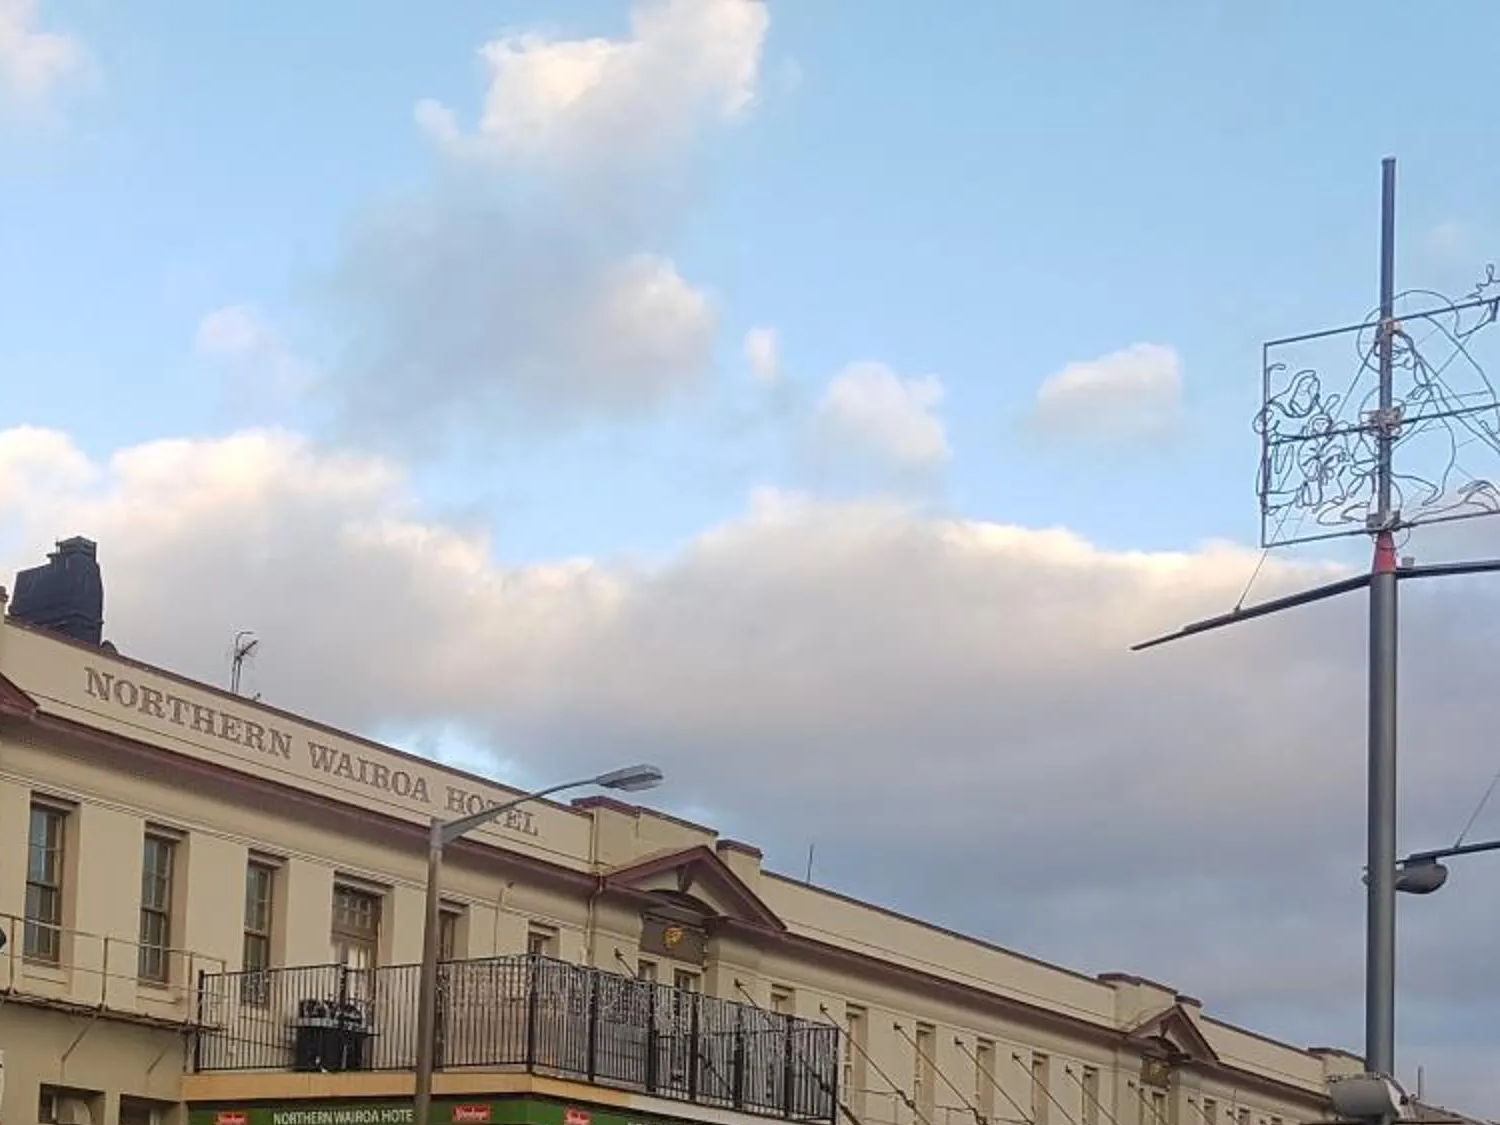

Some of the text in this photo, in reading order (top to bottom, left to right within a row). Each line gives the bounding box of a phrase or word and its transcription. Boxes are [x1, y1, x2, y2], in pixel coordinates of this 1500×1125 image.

[83, 666, 293, 760] NORTHERN
[308, 741, 432, 804] WAIROA
[273, 1111, 333, 1125] NORTHERN
[334, 1109, 379, 1124] WAIROA
